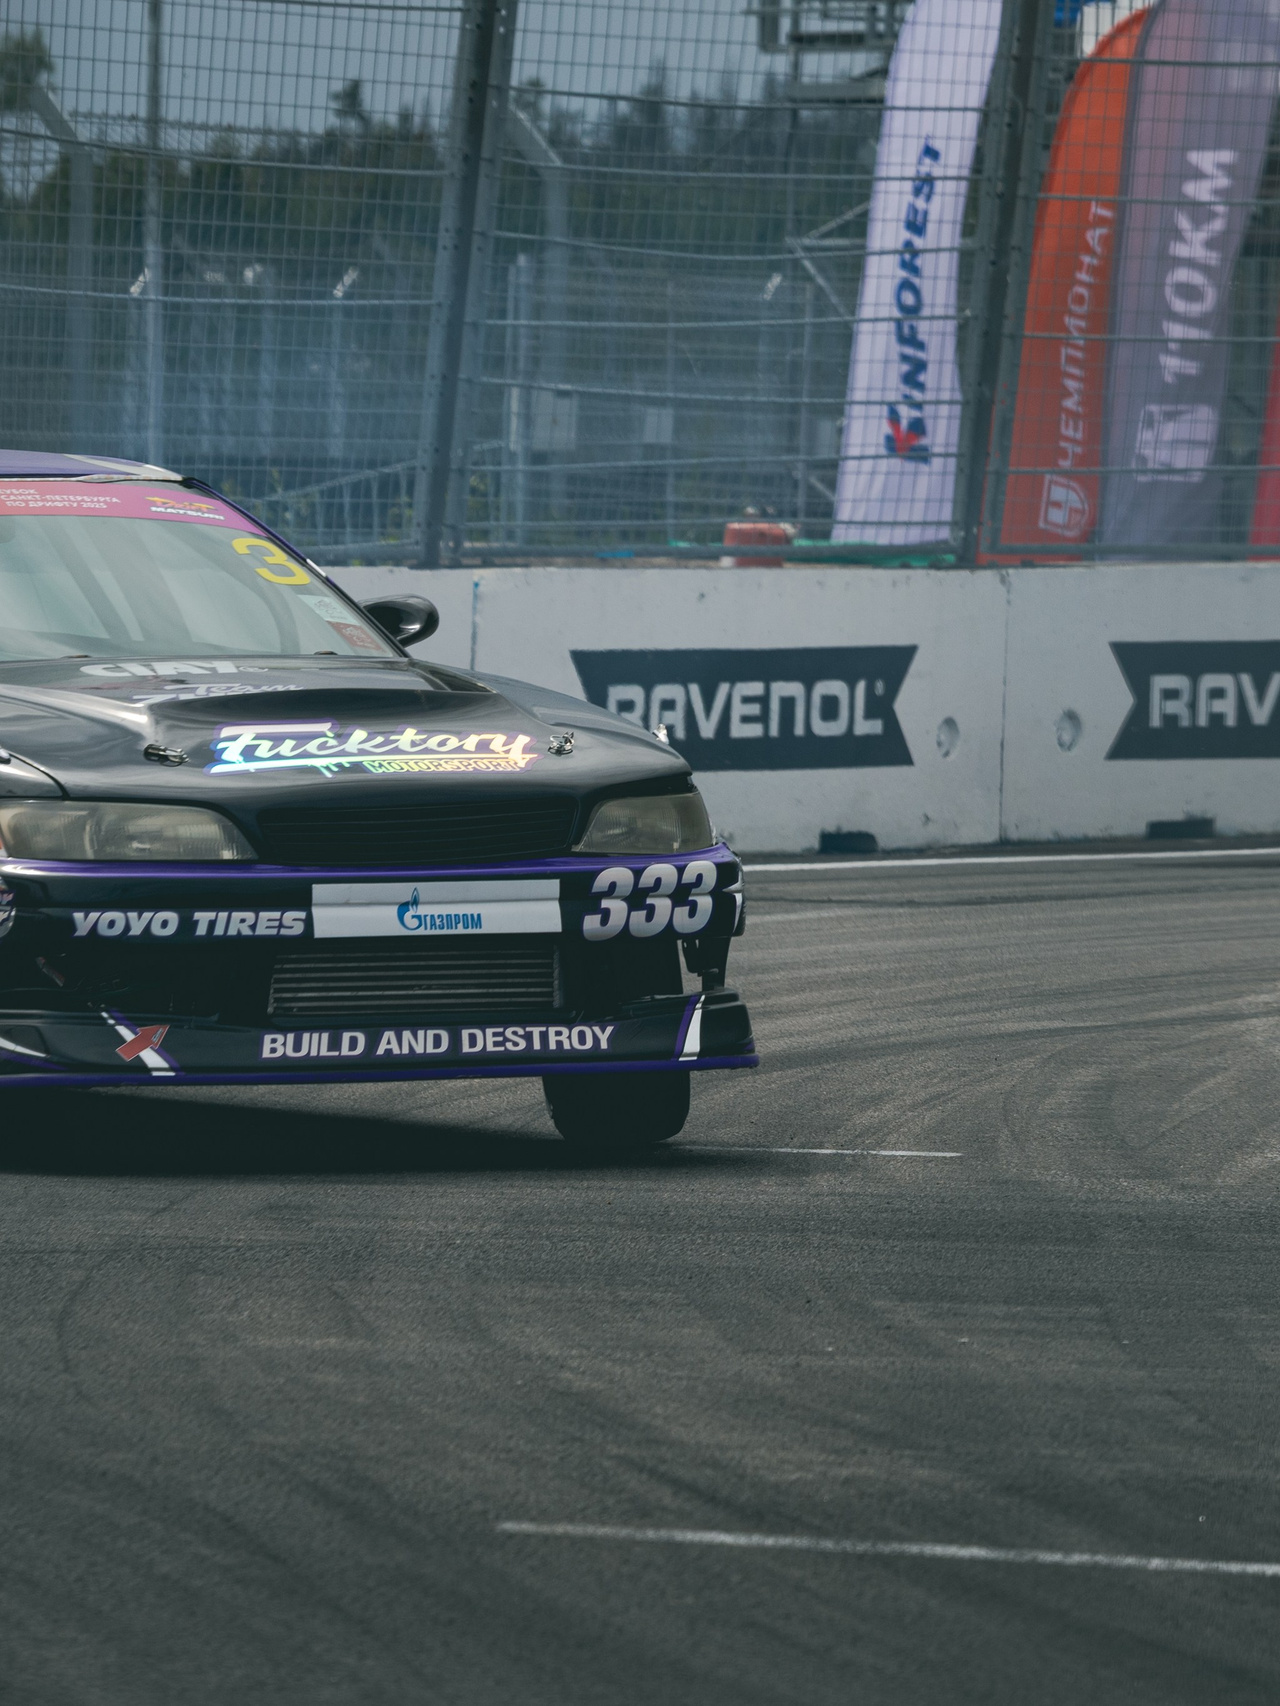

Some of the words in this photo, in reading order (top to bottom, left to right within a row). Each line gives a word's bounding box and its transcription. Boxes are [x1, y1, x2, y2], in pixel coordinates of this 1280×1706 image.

[883, 135, 941, 465] KINFOREST
[1058, 199, 1115, 469] ЧЕМПИОНАТ
[231, 538, 311, 586] 3
[164, 683, 304, 697] Team
[606, 679, 885, 740] RAVENOL
[367, 759, 520, 774] MOTORSPORT
[73, 911, 180, 937] YOYO
[191, 910, 307, 936] TIRES
[582, 861, 717, 941] 333
[261, 1031, 364, 1059] BUILD
[375, 1029, 449, 1056] AND
[462, 1025, 614, 1053] DESTROY
